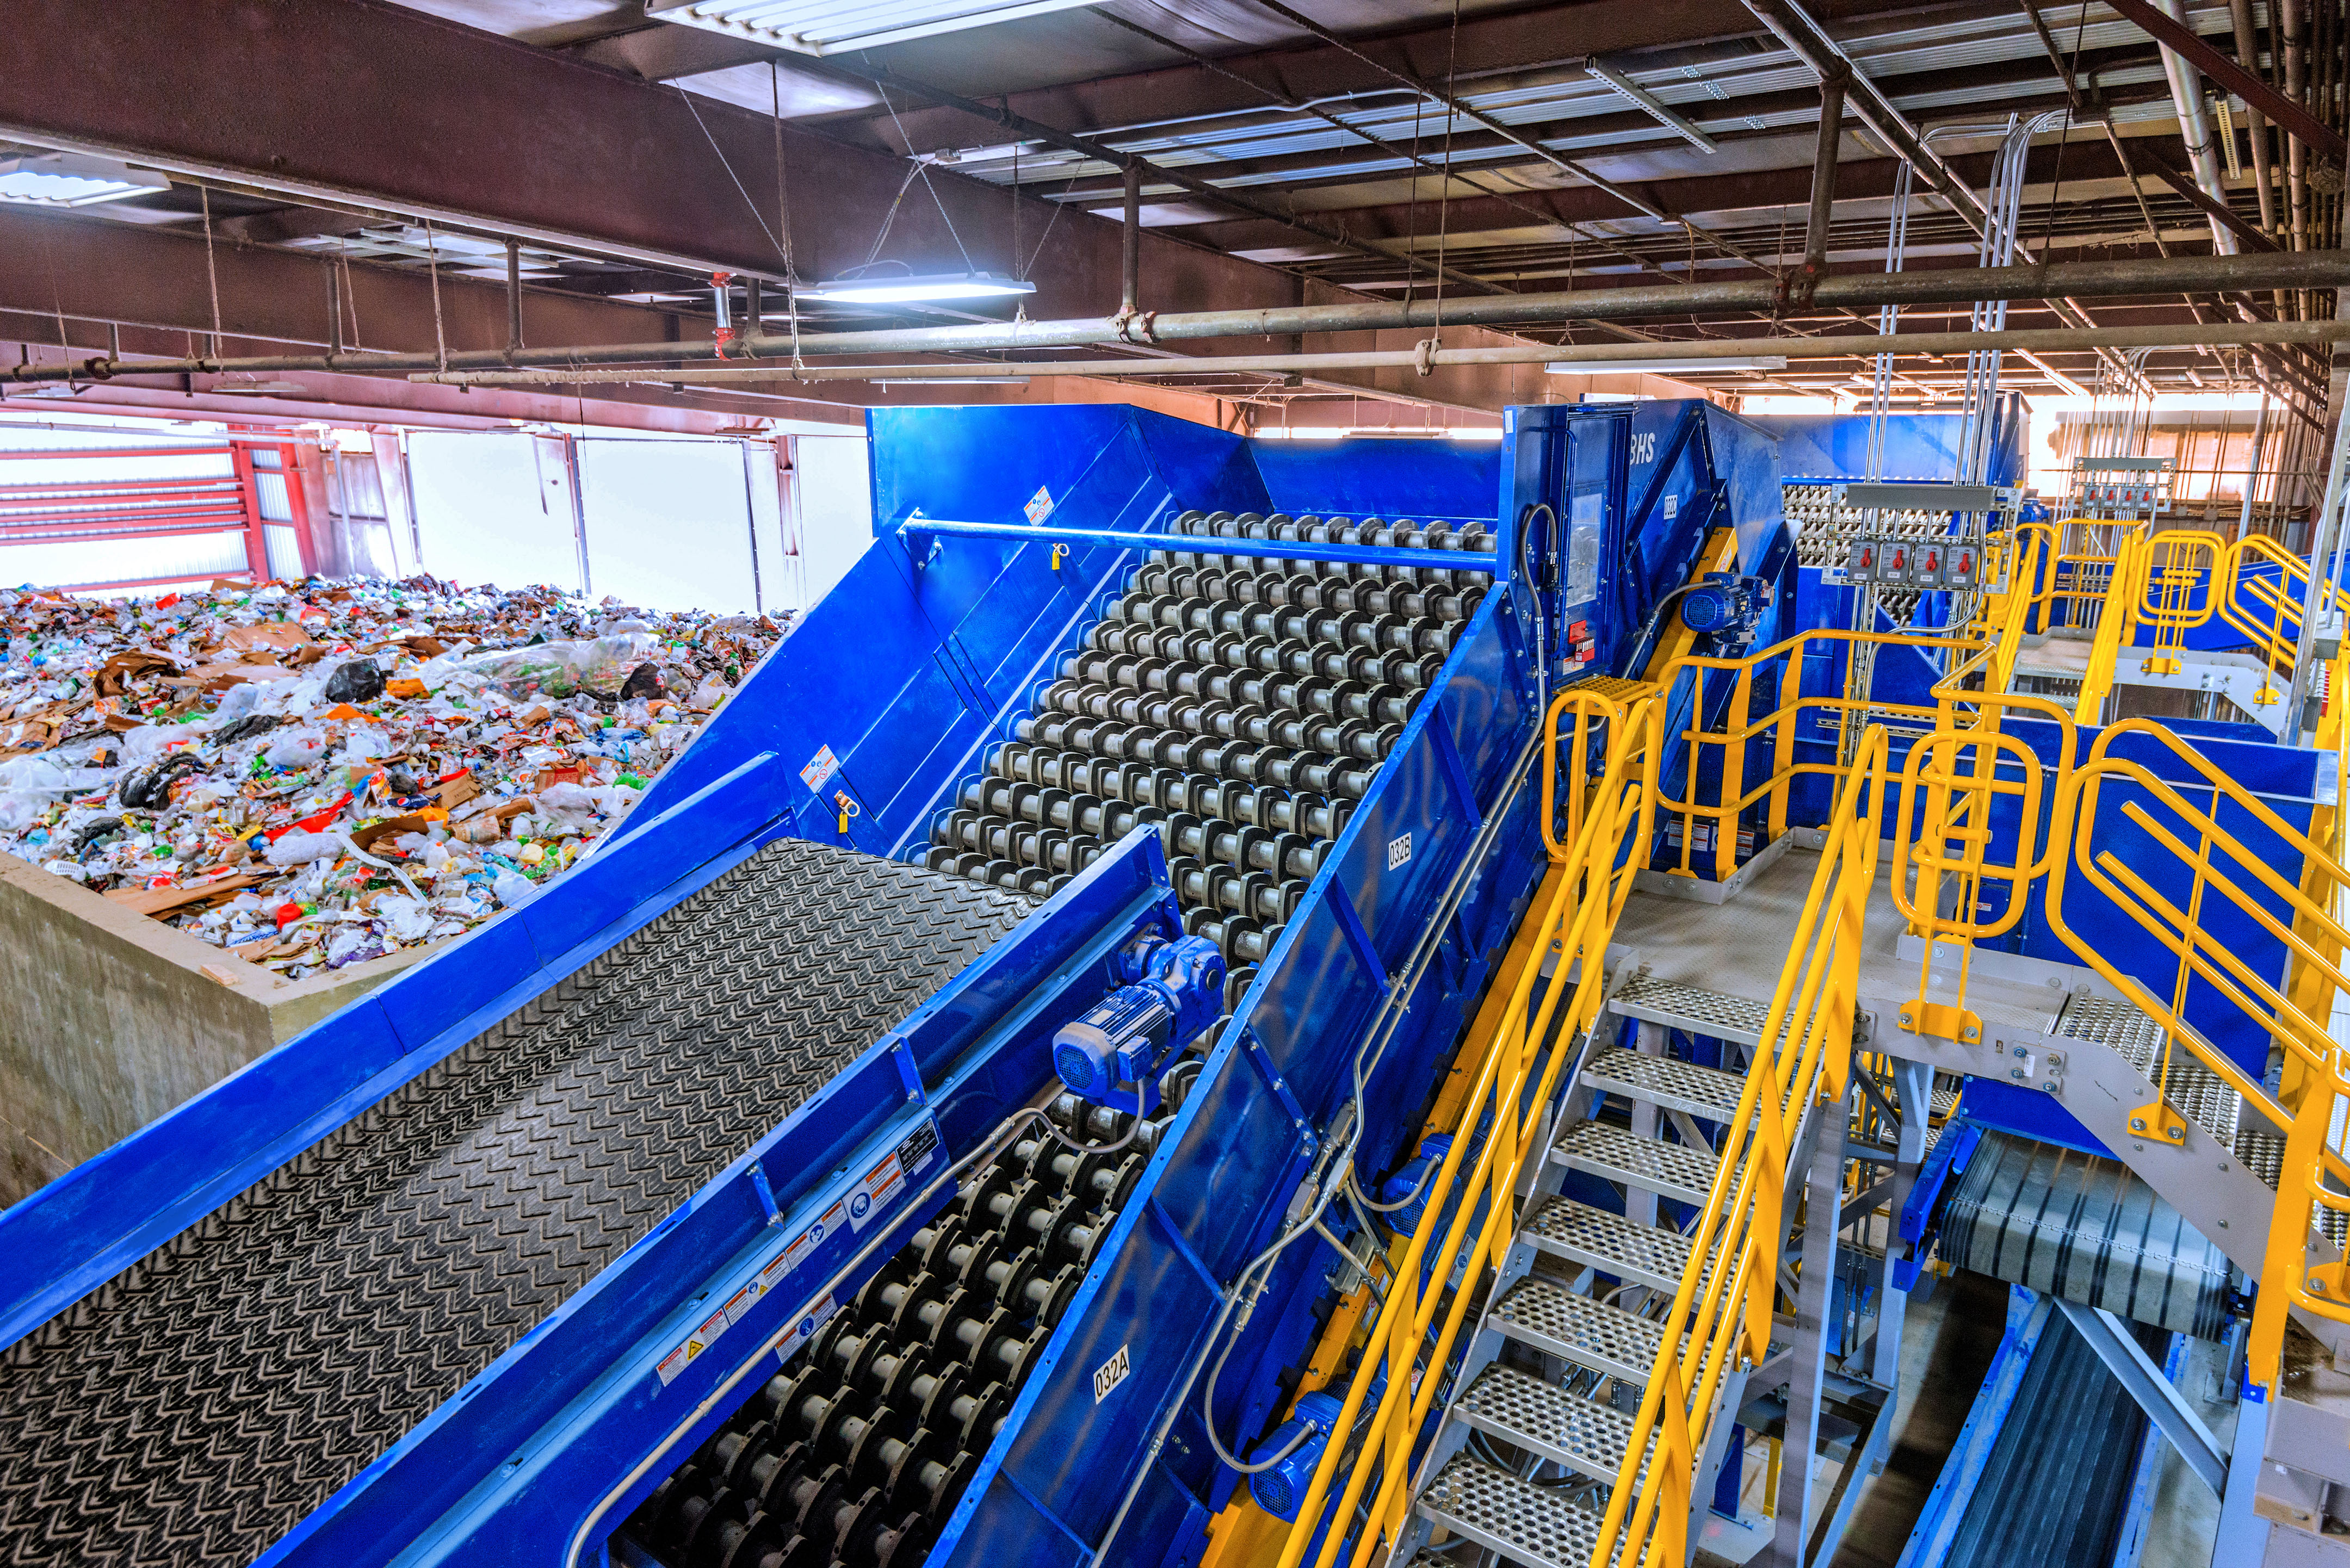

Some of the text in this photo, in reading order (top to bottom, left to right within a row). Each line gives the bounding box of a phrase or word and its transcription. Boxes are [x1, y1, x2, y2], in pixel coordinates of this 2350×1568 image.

[1630, 432, 1655, 465] BHS
[1665, 497, 1677, 516] 032C
[1390, 836, 1410, 866] 032B
[706, 1312, 721, 1327] DANGER
[1096, 1351, 1129, 1397] 032A
